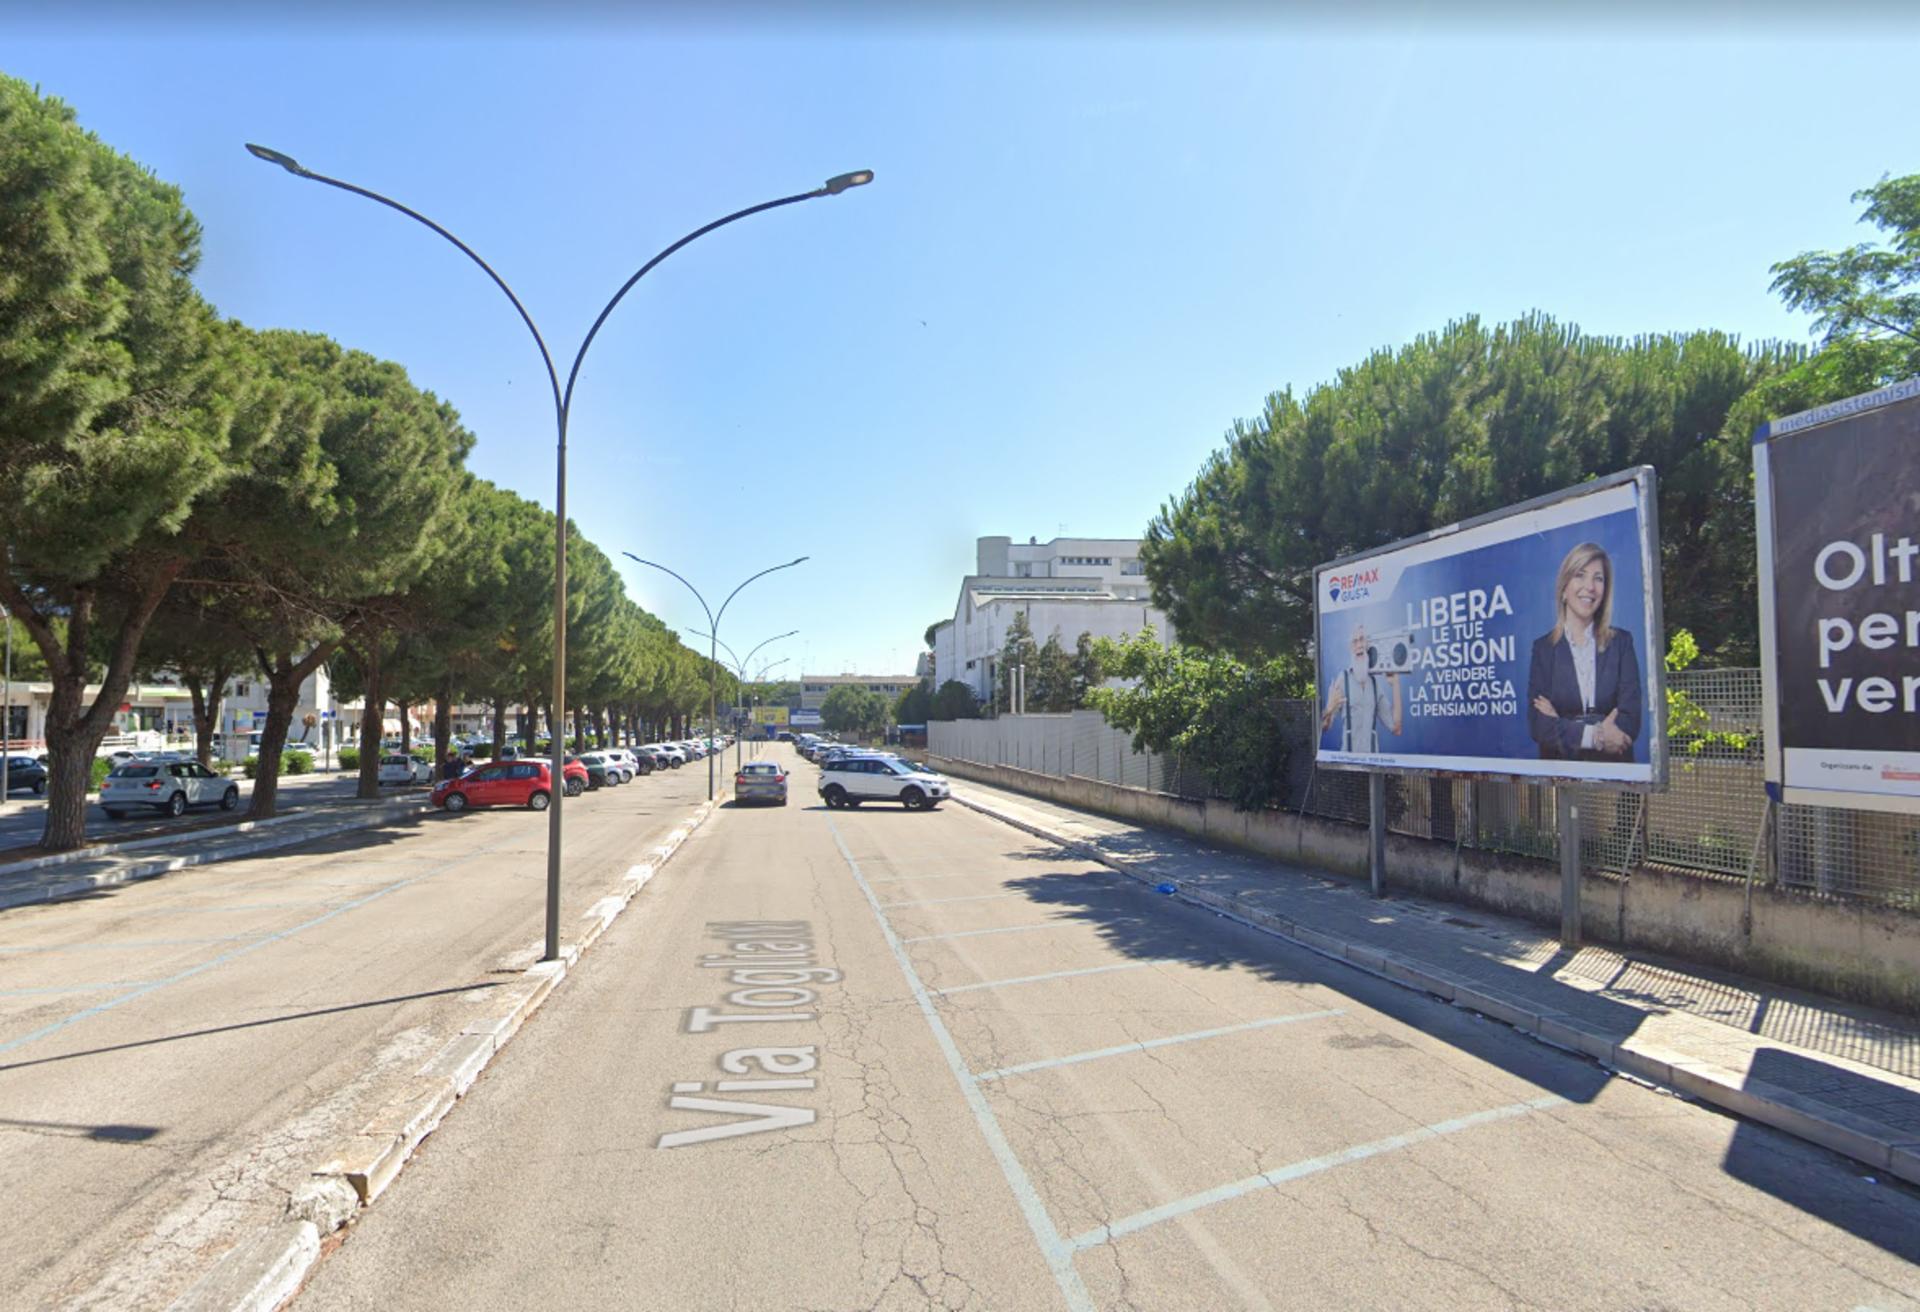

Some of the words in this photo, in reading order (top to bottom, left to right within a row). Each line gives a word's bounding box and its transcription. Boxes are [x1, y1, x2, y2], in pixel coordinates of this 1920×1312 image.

[1406, 584, 1513, 630] LIBERA
[1432, 626, 1449, 644] LE
[1453, 621, 1484, 641] TUE
[1408, 635, 1515, 670] PASSIONI
[1424, 671, 1434, 684] A
[1436, 665, 1496, 683] VENDERE
[1409, 685, 1428, 702] LA
[1431, 682, 1464, 701] TUA
[1467, 679, 1516, 700] CASA
[1409, 703, 1420, 716] CI
[1423, 702, 1488, 716] PENSIAMO
[1491, 700, 1517, 715] NOI
